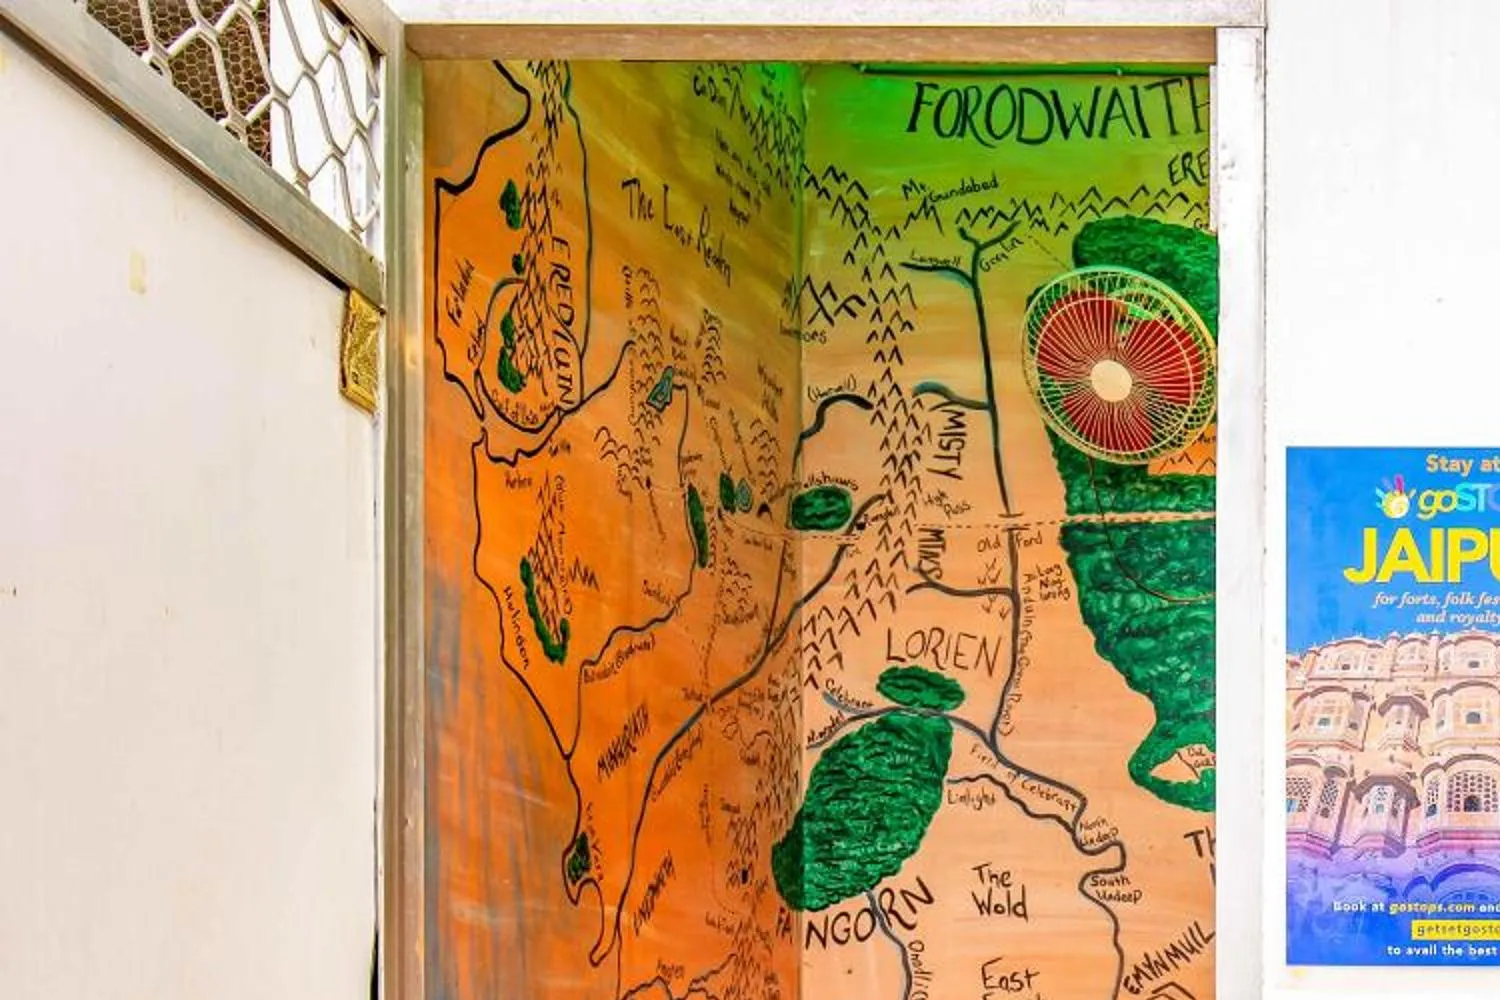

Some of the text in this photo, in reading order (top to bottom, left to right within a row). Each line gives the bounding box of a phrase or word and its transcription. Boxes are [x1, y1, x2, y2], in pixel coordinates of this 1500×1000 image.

[1426, 454, 1474, 476] Stay
[977, 536, 1001, 553] Old
[1372, 591, 1397, 608] for
[1400, 592, 1440, 608] forts,
[1444, 591, 1474, 608] folk
[1416, 609, 1446, 624] and
[887, 627, 1001, 677] LORIEN
[972, 862, 1012, 888] The
[972, 885, 1029, 921] Wold
[1333, 900, 1367, 912] Book
[1371, 902, 1385, 912] at
[1389, 902, 1475, 915] gostops.com
[1387, 945, 1401, 955] to
[1405, 944, 1437, 955] avail
[1442, 944, 1464, 955] the
[1469, 944, 1497, 956] best
[981, 957, 1041, 991] East
